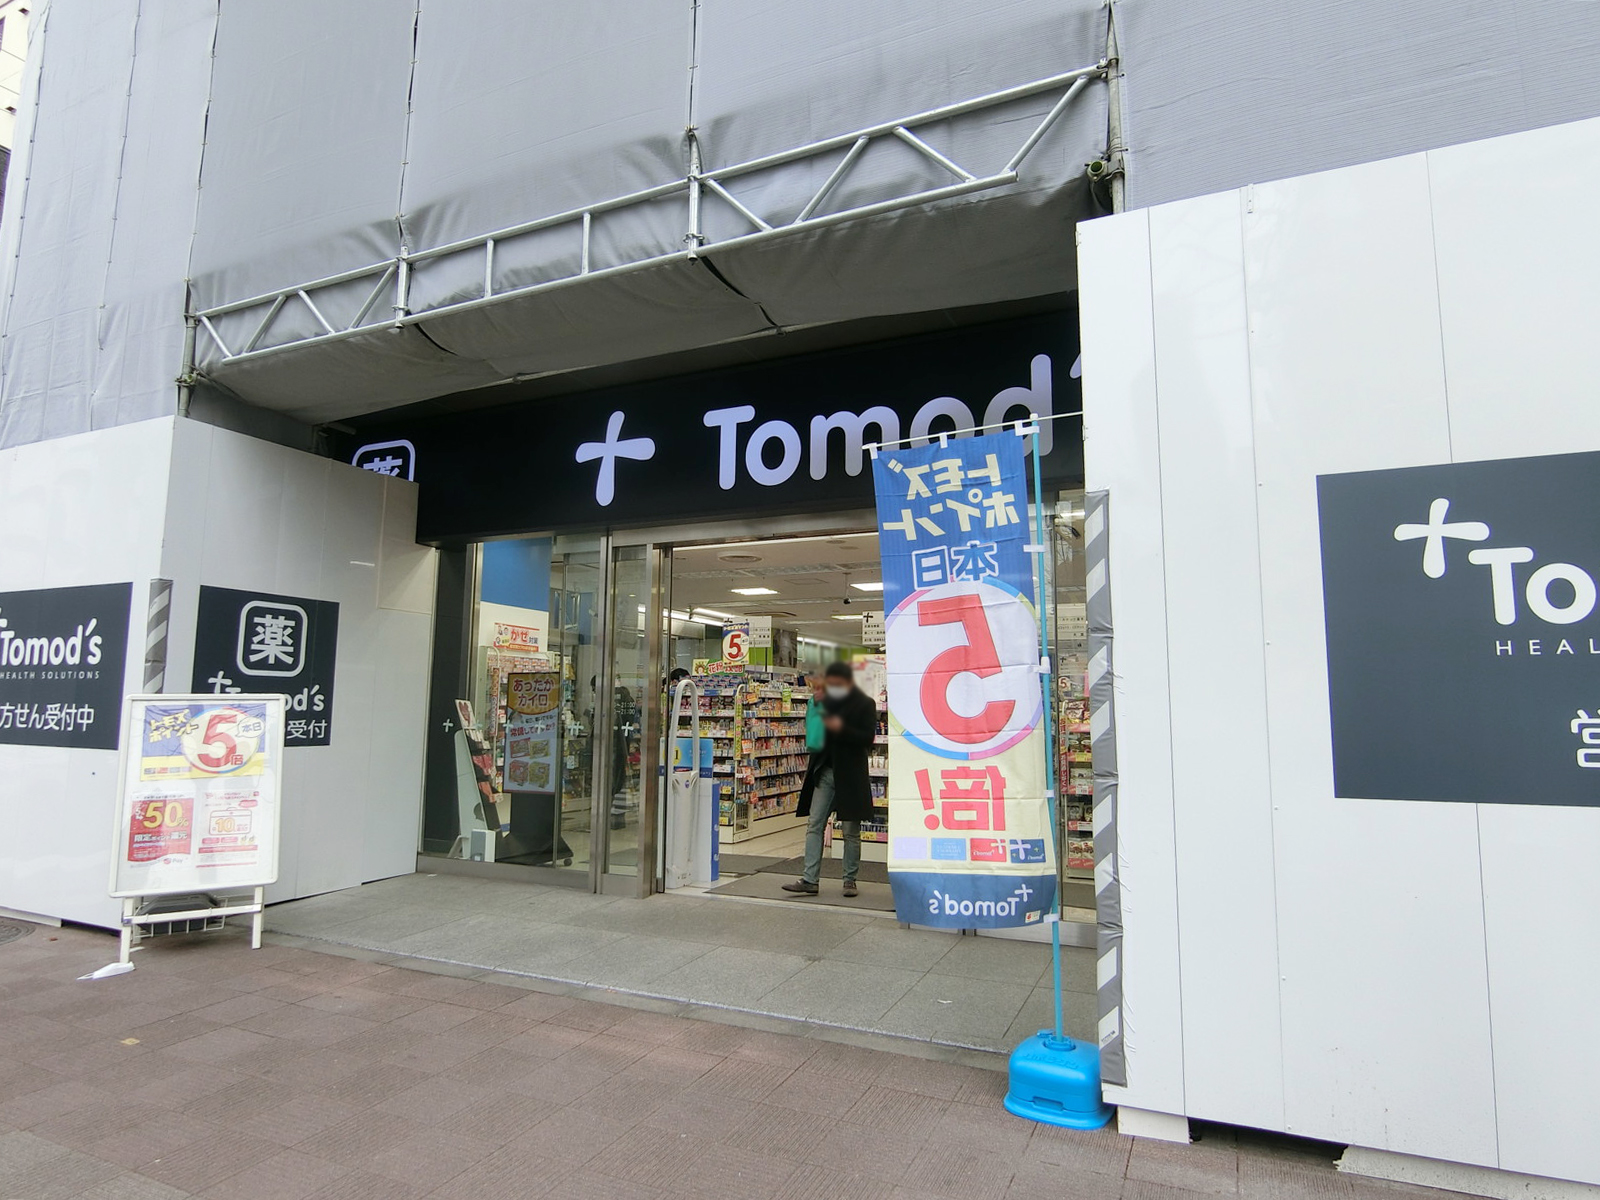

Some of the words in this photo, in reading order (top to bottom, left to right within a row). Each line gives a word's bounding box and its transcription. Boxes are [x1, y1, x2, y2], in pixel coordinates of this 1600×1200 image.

[0, 618, 102, 666] Tomod's
[248, 614, 296, 665] 薬
[728, 633, 743, 659] 5
[41, 671, 100, 679] SOLUTIONS
[513, 679, 554, 693] あったか
[518, 694, 549, 707] カイロ
[241, 721, 262, 733] 本日
[197, 714, 238, 768] 5
